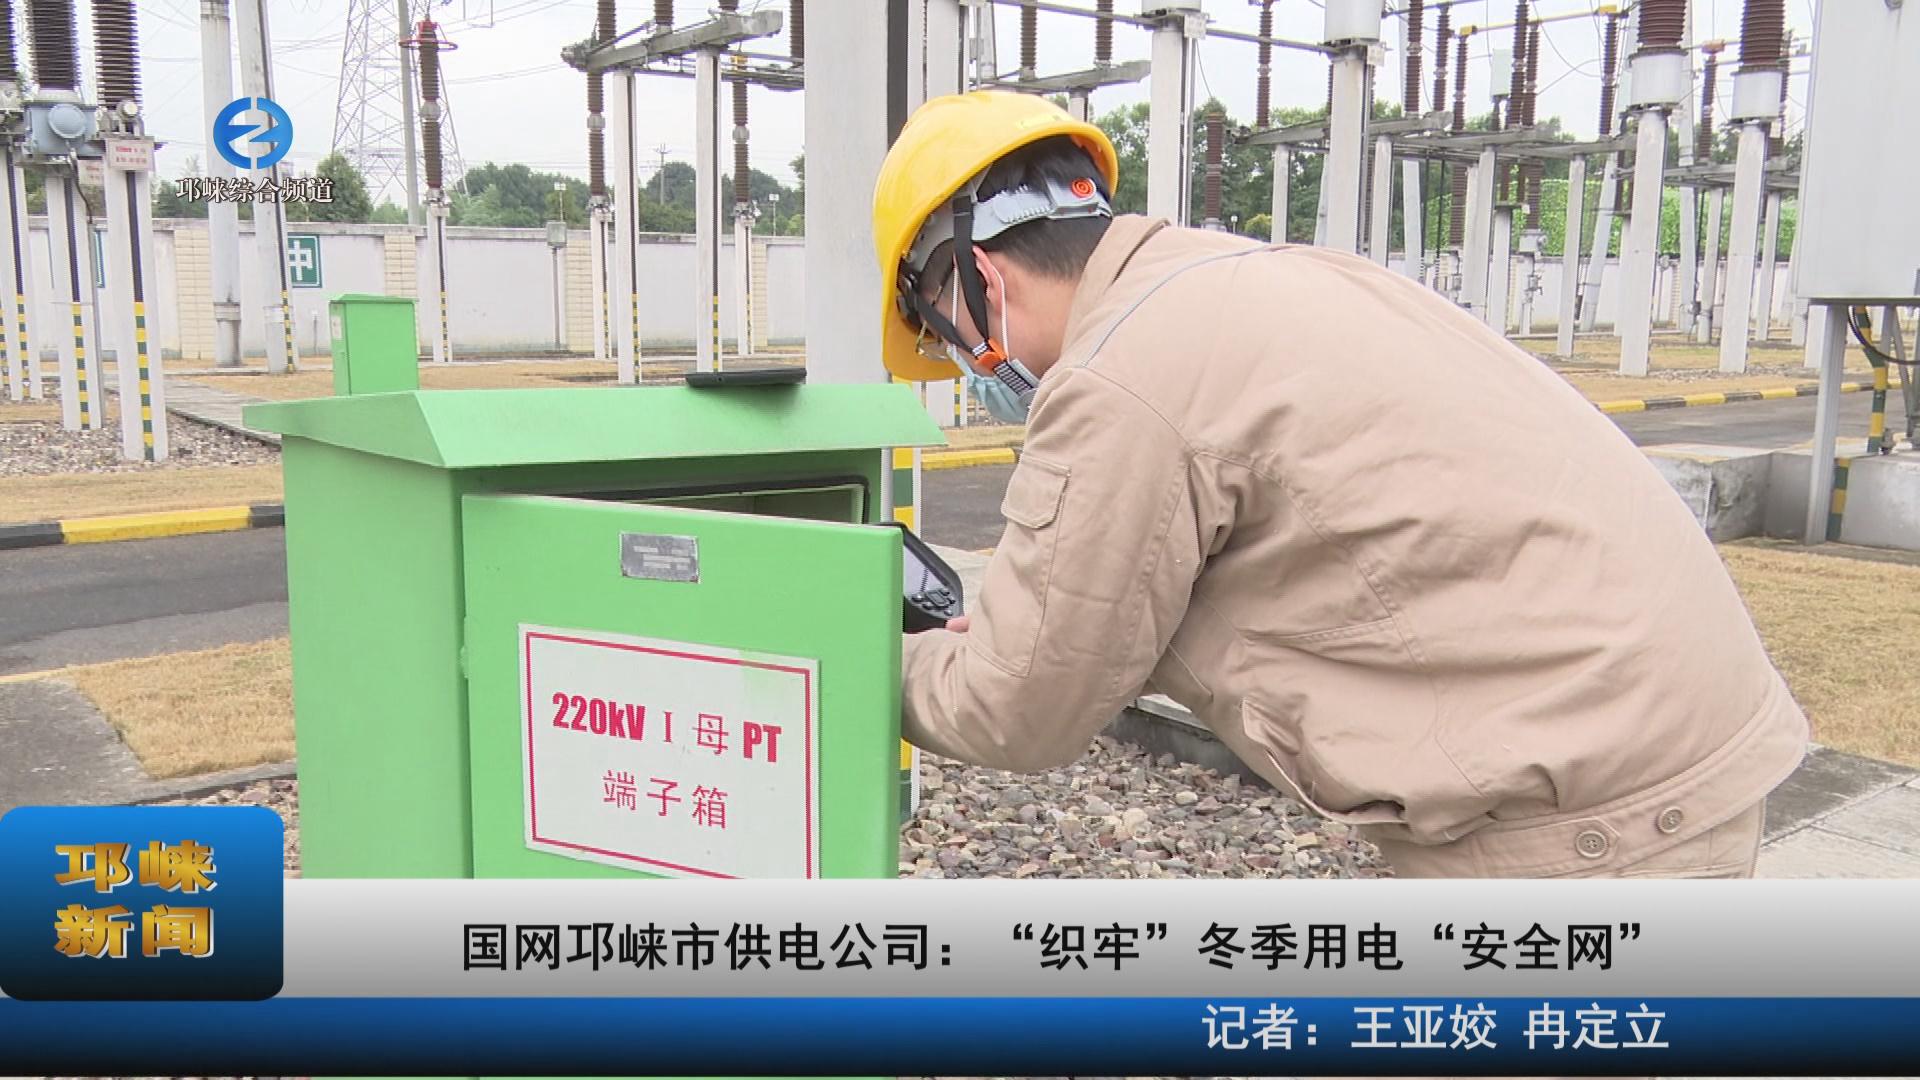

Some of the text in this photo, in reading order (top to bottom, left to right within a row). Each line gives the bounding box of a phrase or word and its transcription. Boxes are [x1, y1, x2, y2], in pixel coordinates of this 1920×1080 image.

[552, 692, 646, 742] 220kV
[743, 721, 782, 763] PT
[602, 769, 729, 829] 端子箱
